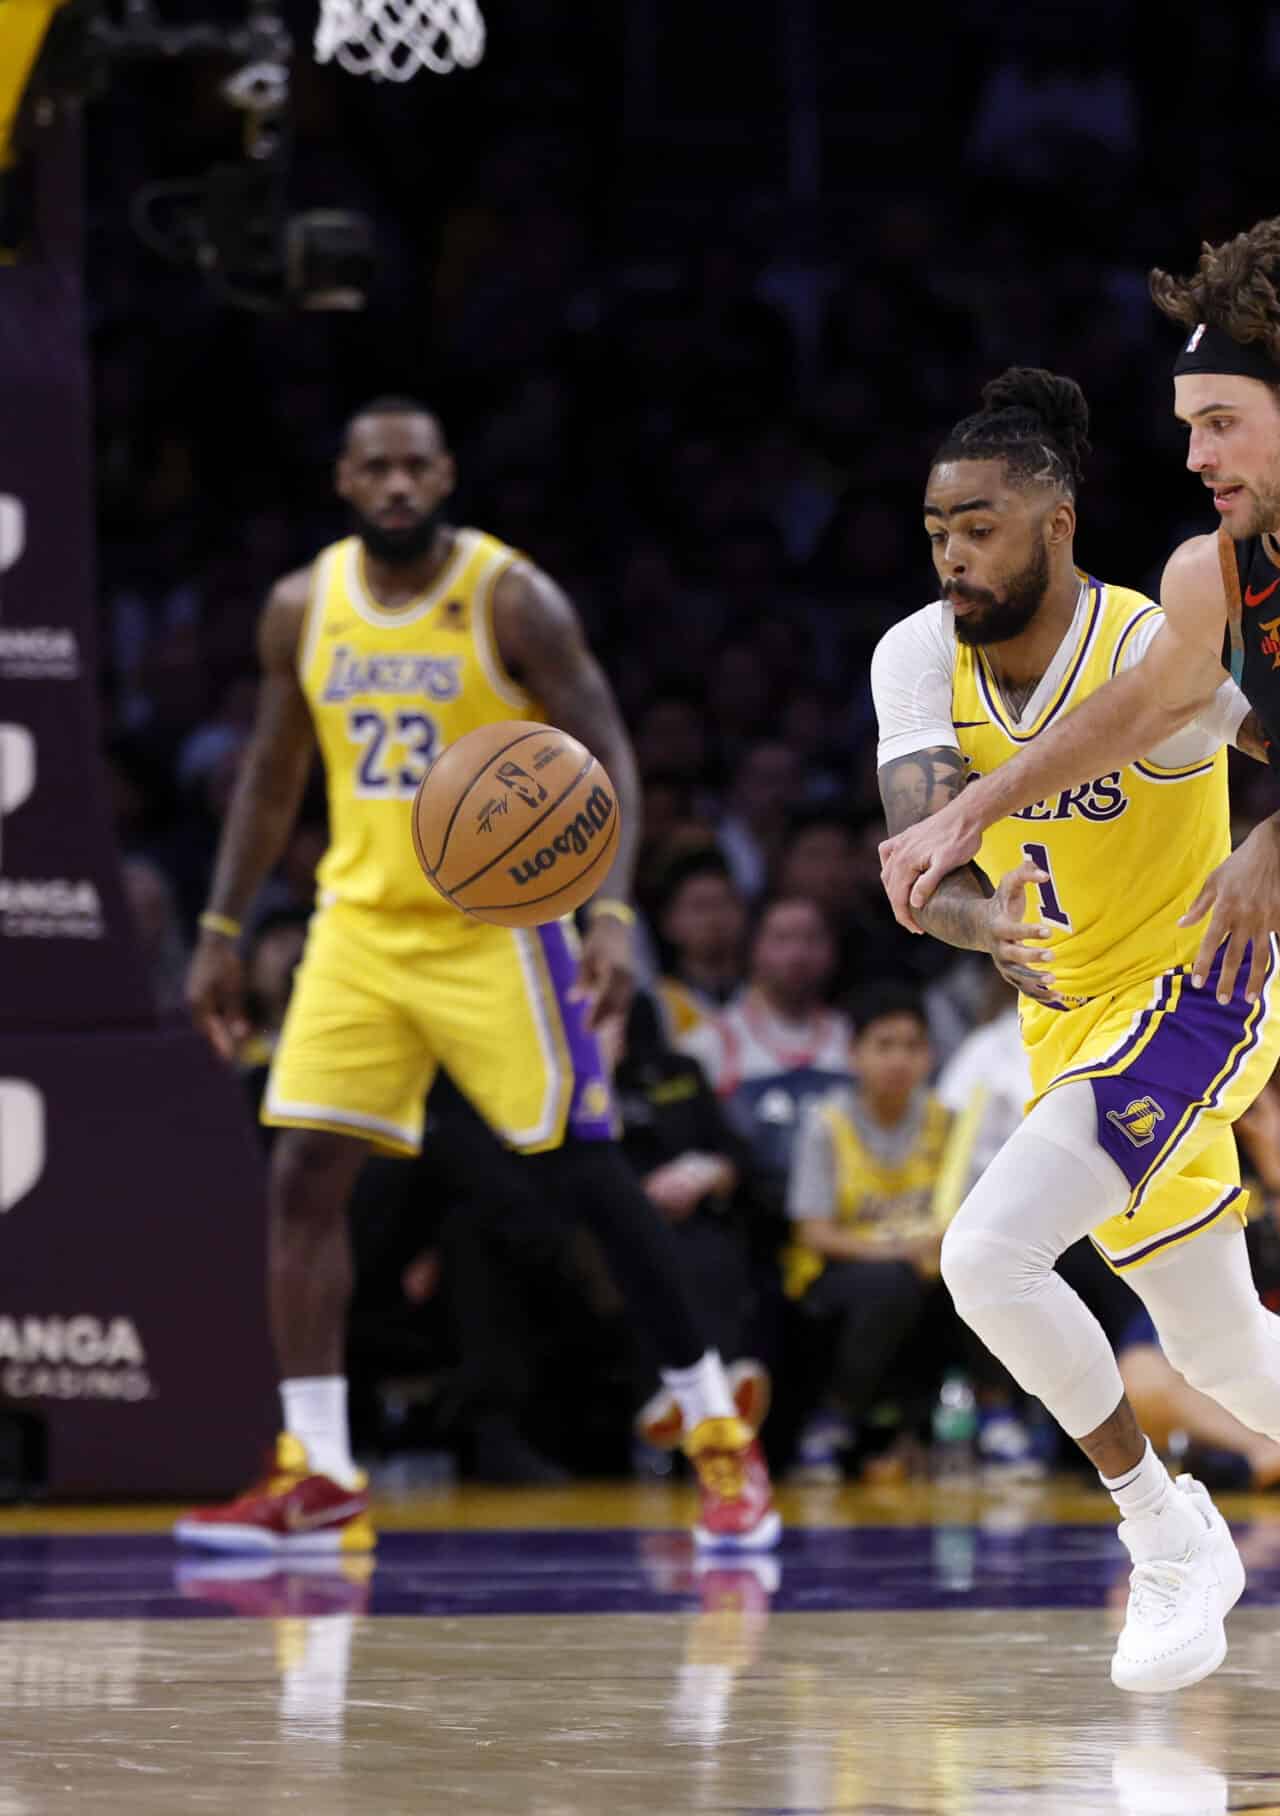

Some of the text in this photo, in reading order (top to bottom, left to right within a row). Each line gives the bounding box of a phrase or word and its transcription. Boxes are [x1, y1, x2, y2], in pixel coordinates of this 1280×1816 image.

[319, 645, 464, 702] LAKERS
[346, 706, 441, 798] 23
[509, 784, 613, 885] Wilson
[1020, 840, 1073, 934] 1
